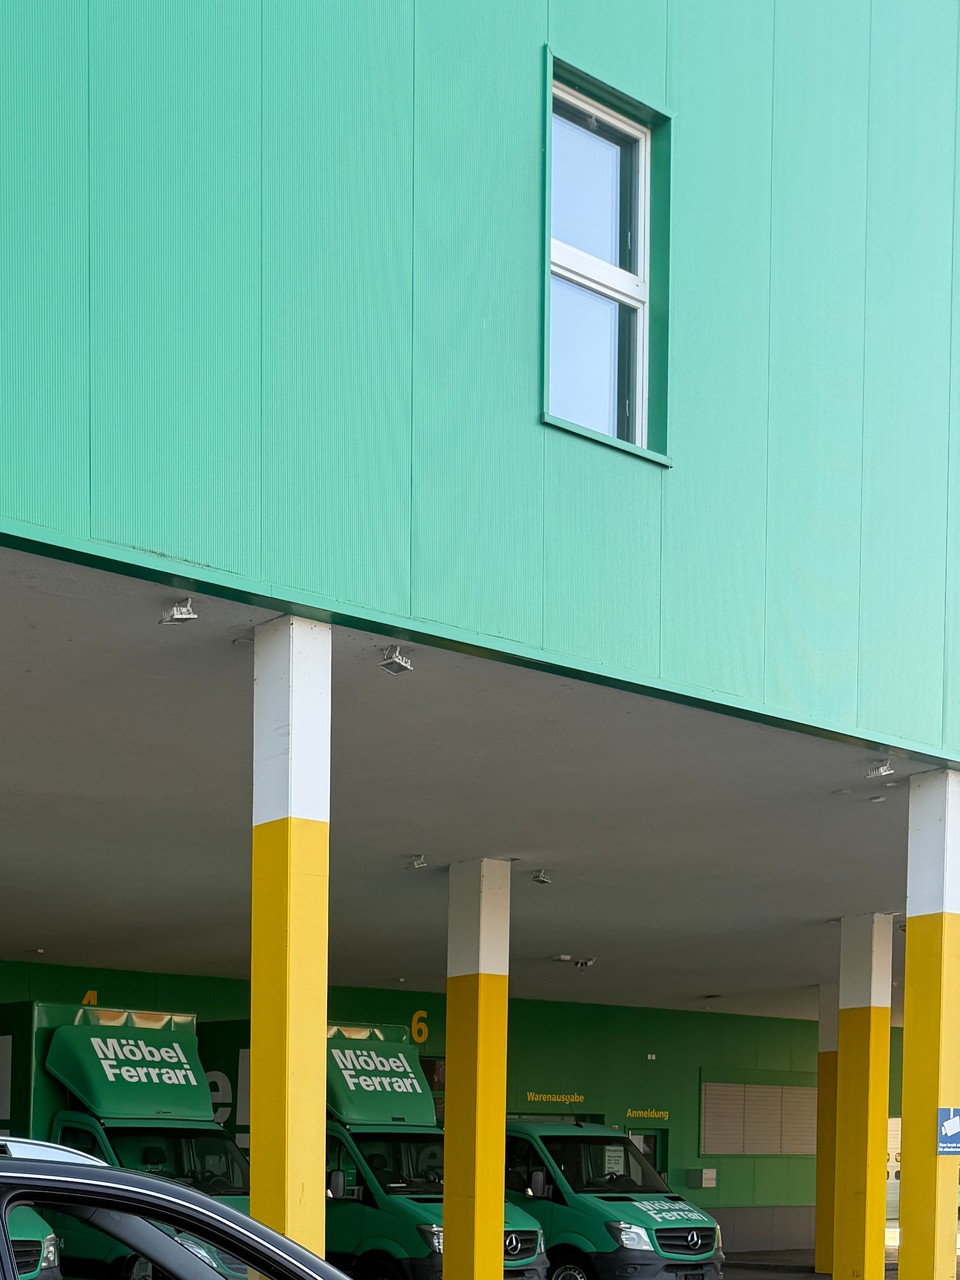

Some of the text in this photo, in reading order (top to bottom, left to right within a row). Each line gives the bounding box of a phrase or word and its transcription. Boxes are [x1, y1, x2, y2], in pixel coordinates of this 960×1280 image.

[411, 1010, 429, 1043] 6
[90, 1037, 187, 1064] Möbel
[331, 1048, 412, 1073] Möbel
[100, 1059, 197, 1086] Ferrari
[341, 1069, 422, 1093] Ferrari
[527, 1091, 584, 1104] Warenausgabe
[626, 1108, 669, 1120] Anmeldung
[632, 1200, 697, 1211] Möbel
[647, 1210, 708, 1222] Ferrari
